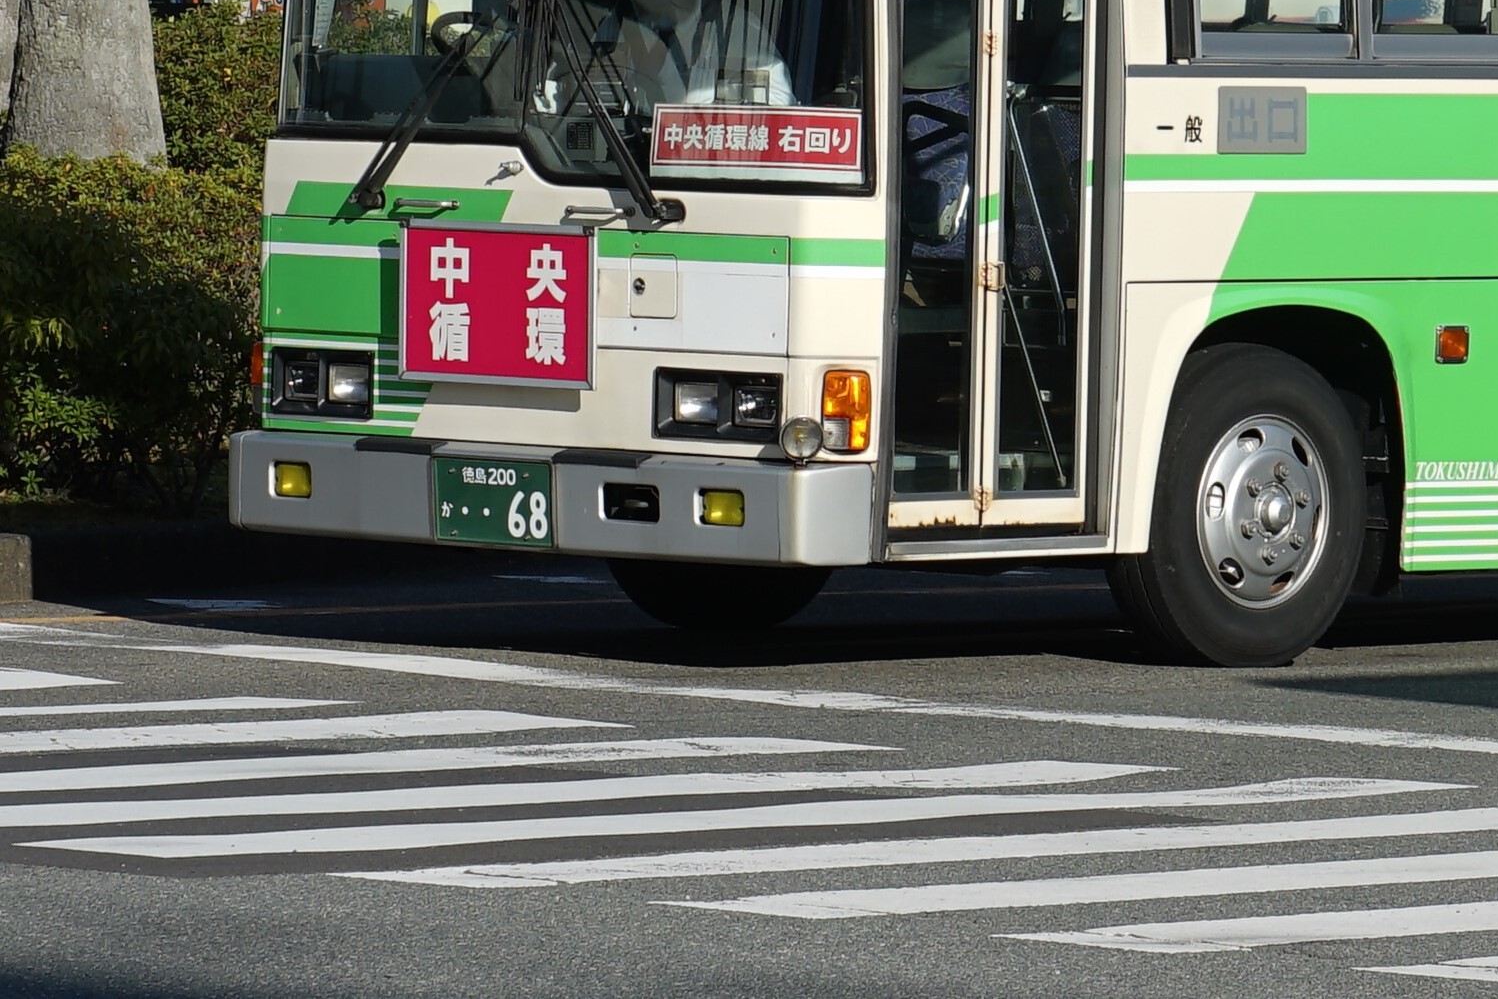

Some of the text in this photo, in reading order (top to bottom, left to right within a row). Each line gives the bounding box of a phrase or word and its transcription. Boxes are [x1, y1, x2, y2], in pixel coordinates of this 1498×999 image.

[663, 123, 853, 155] 中央循環線 右回り
[1156, 115, 1203, 143] 一般
[1225, 96, 1300, 144] 出口
[430, 237, 568, 303] 中央
[429, 301, 567, 366] 循環
